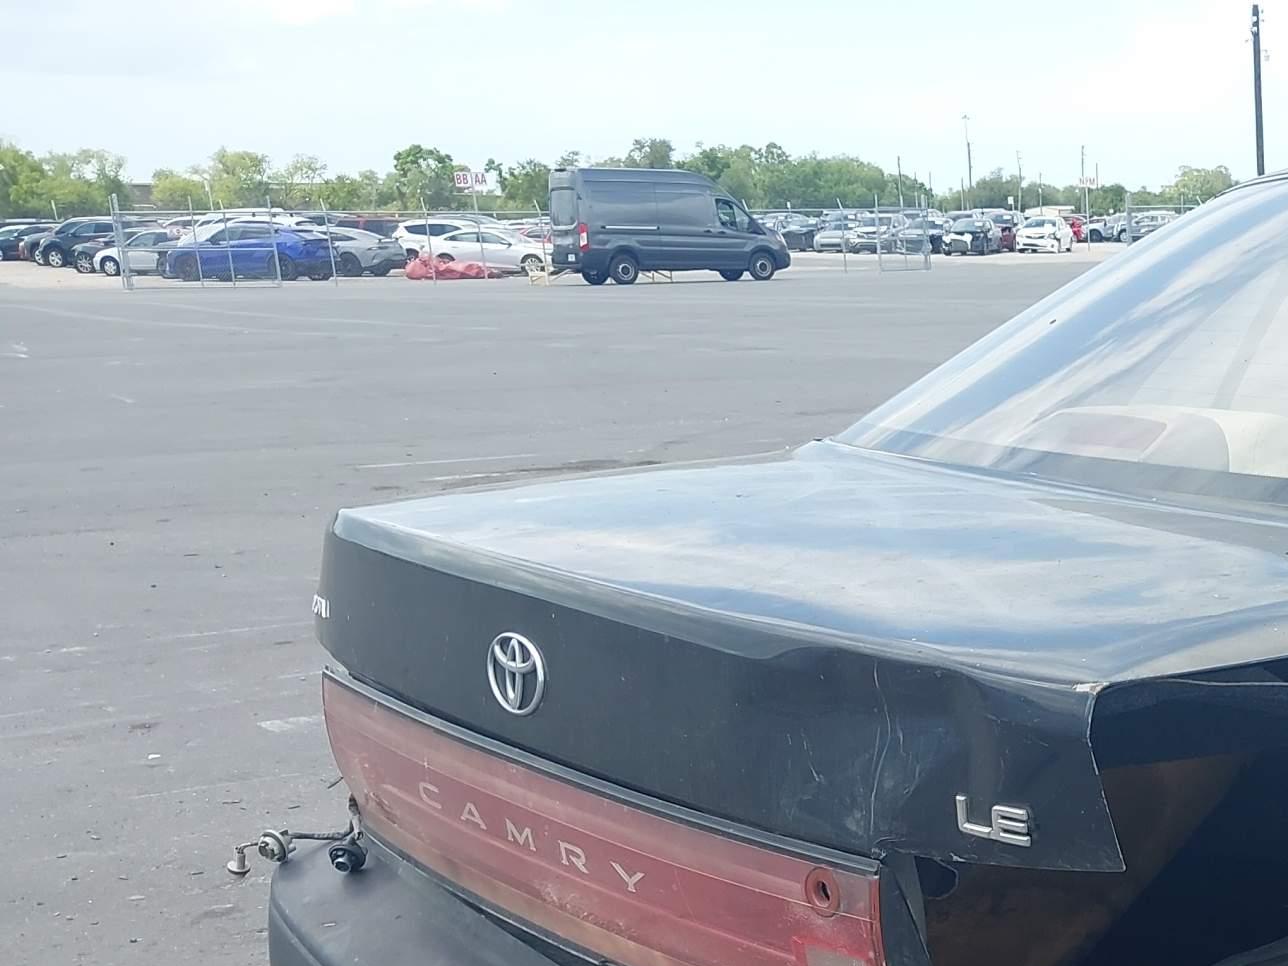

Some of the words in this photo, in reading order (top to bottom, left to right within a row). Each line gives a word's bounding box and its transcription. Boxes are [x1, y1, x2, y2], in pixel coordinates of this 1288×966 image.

[456, 173, 468, 184] BB
[475, 173, 487, 184] AA
[955, 795, 1032, 847] LE
[418, 781, 645, 893] CAMRY
